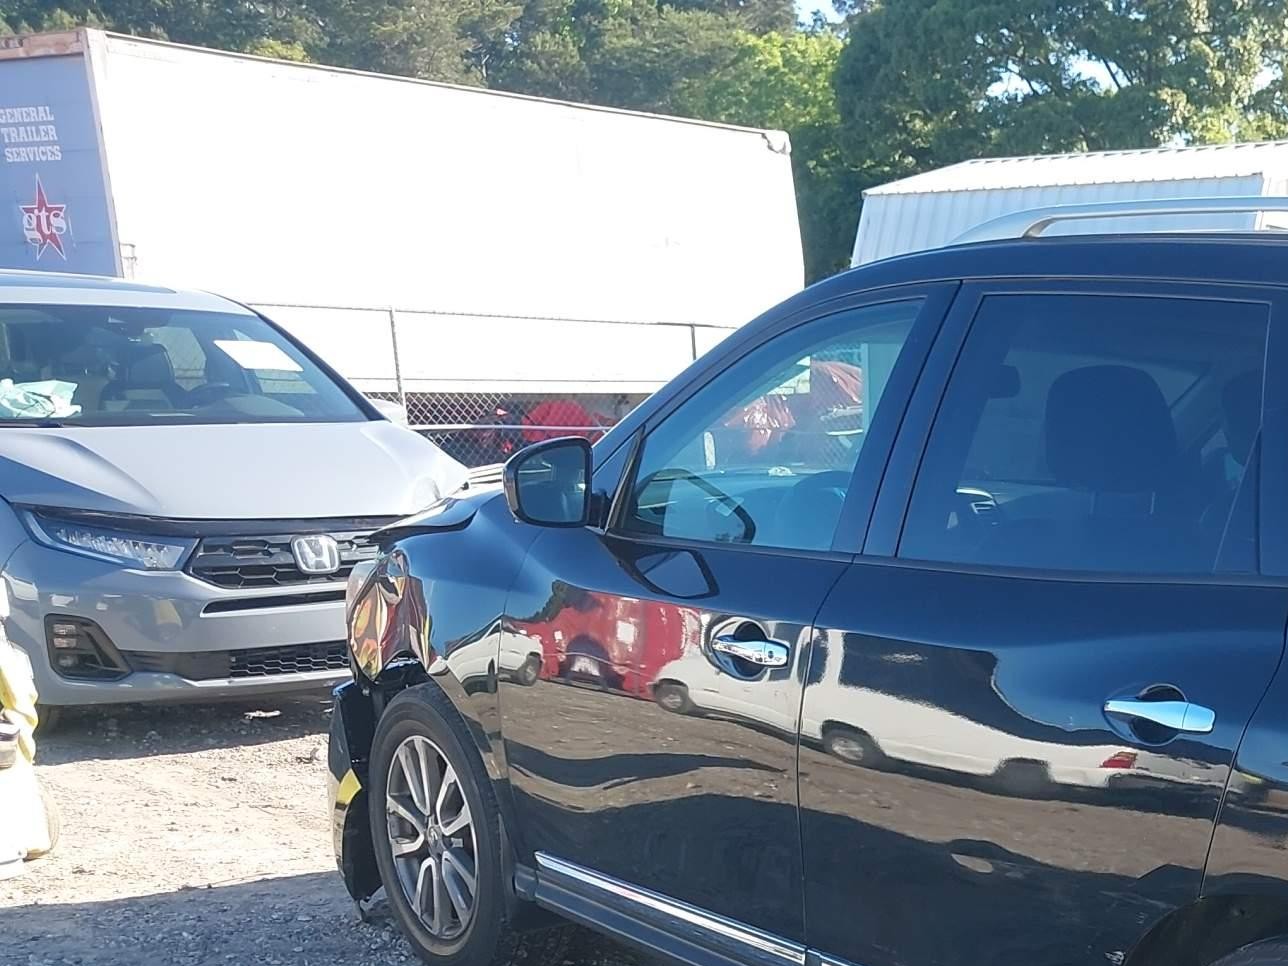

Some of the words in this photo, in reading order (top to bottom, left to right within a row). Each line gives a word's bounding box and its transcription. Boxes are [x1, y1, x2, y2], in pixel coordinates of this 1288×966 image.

[0, 106, 54, 123] GENERAL
[1, 125, 58, 142] TRAILER
[5, 145, 62, 162] SERVICES
[23, 206, 67, 245] gts
